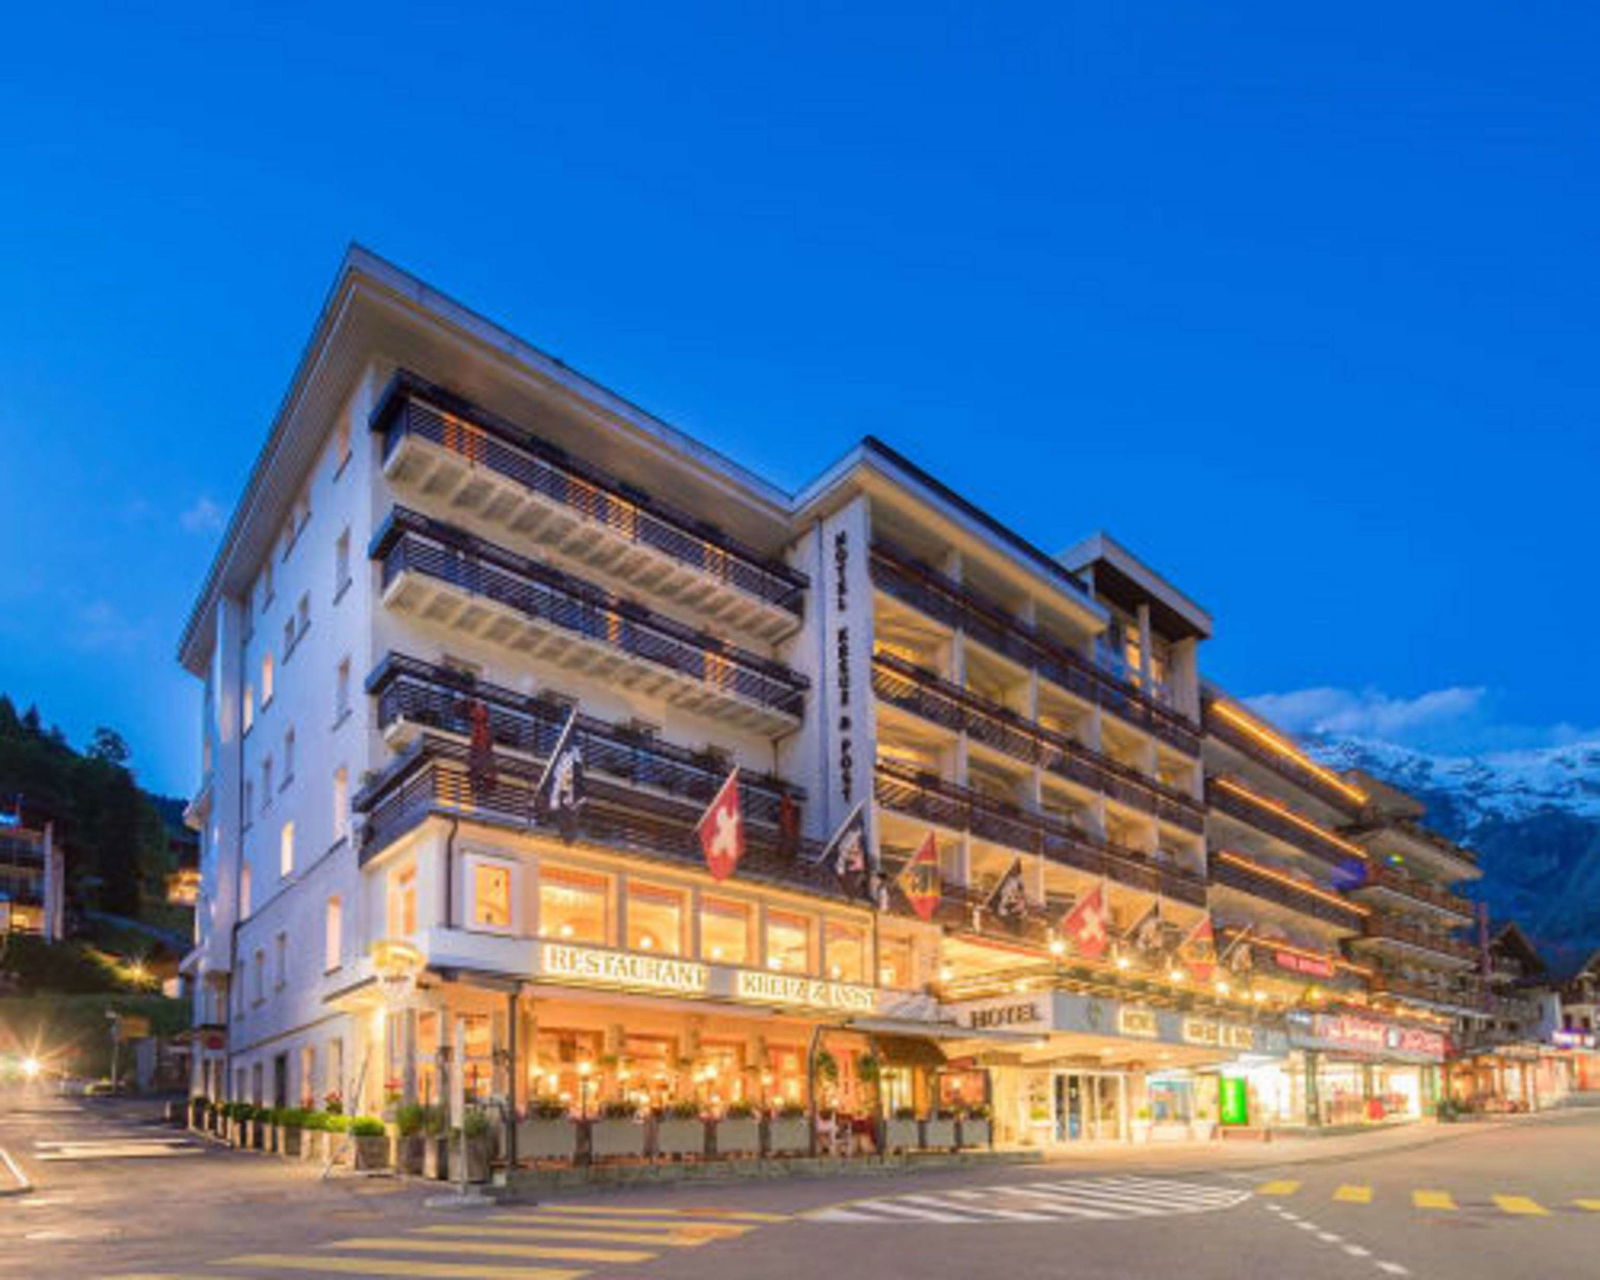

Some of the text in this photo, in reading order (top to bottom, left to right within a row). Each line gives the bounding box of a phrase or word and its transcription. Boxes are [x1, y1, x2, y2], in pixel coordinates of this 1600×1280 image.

[840, 738, 852, 805] POST
[547, 947, 707, 988] RESTAURANT
[969, 1002, 1042, 1030] HOTEL
